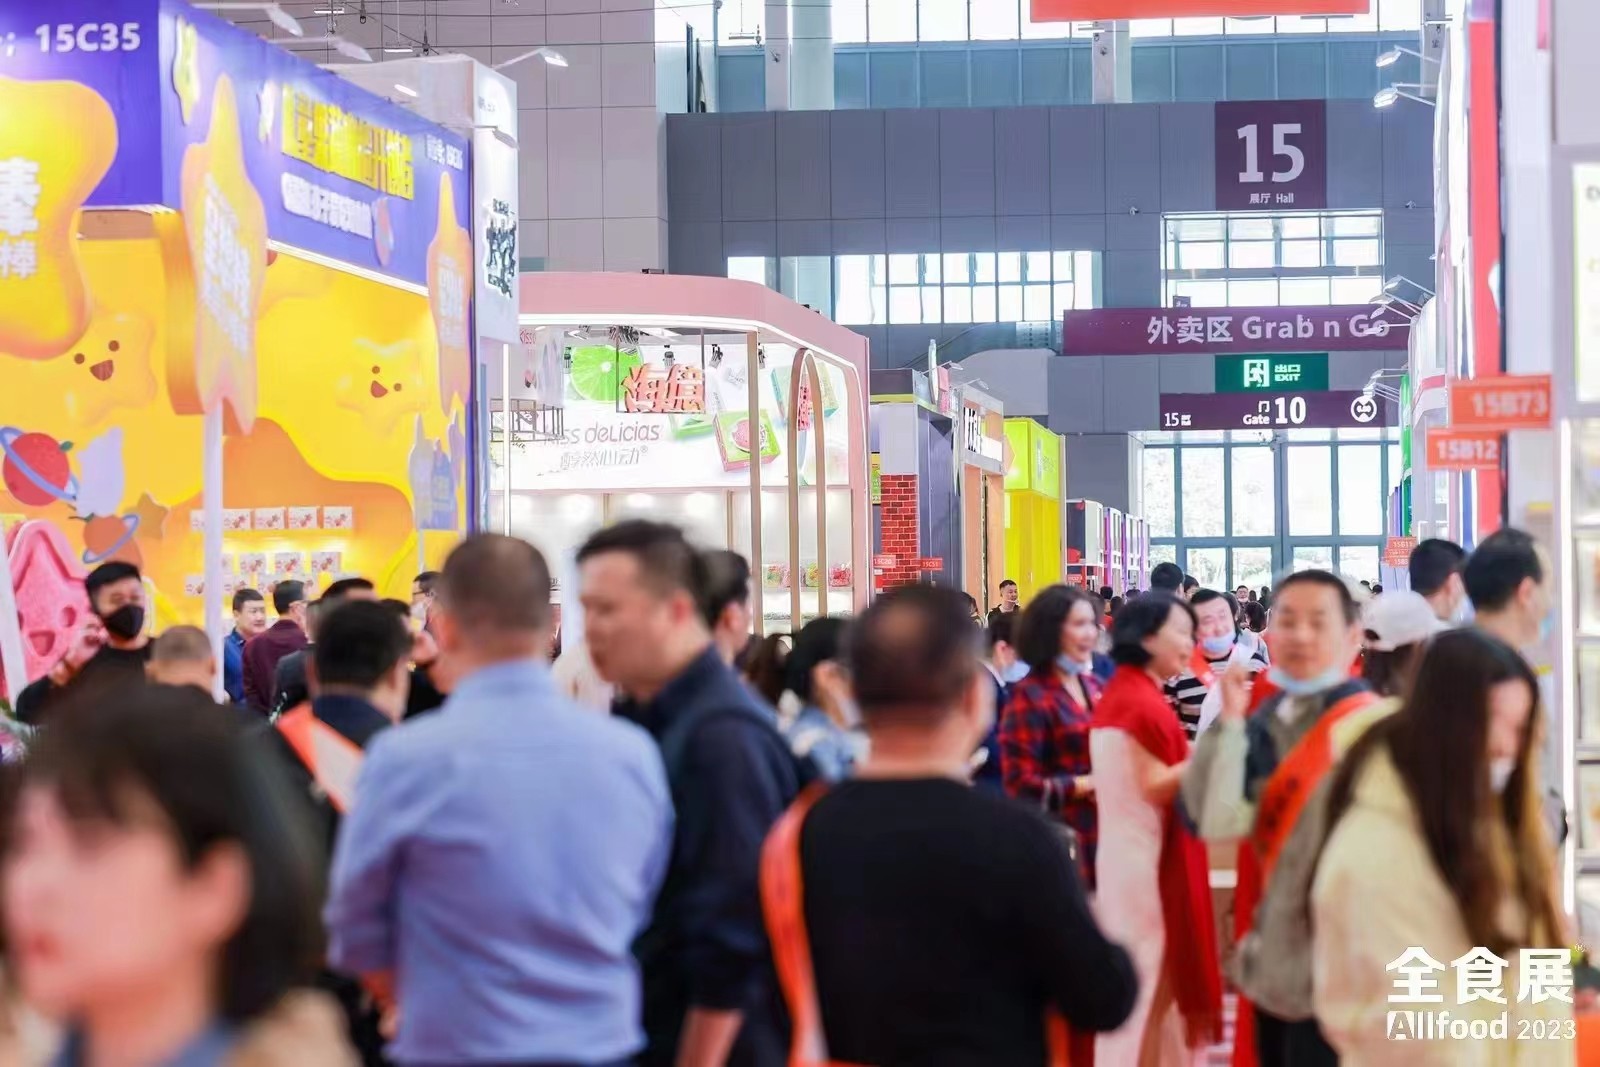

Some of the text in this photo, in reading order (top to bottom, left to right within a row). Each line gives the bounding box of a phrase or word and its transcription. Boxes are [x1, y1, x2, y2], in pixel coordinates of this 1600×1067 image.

[35, 22, 141, 53] 15C35
[1237, 123, 1305, 183] 15
[1249, 192, 1294, 204] 展厅 Hall
[1147, 313, 1390, 345] 外卖区 Grab n Go
[1274, 364, 1301, 373] 出口
[1274, 373, 1301, 382] EXIT
[1242, 396, 1306, 425] Gate 10
[1472, 391, 1548, 417] 15B73
[1164, 412, 1179, 427] 15
[1436, 439, 1499, 460] 15B12
